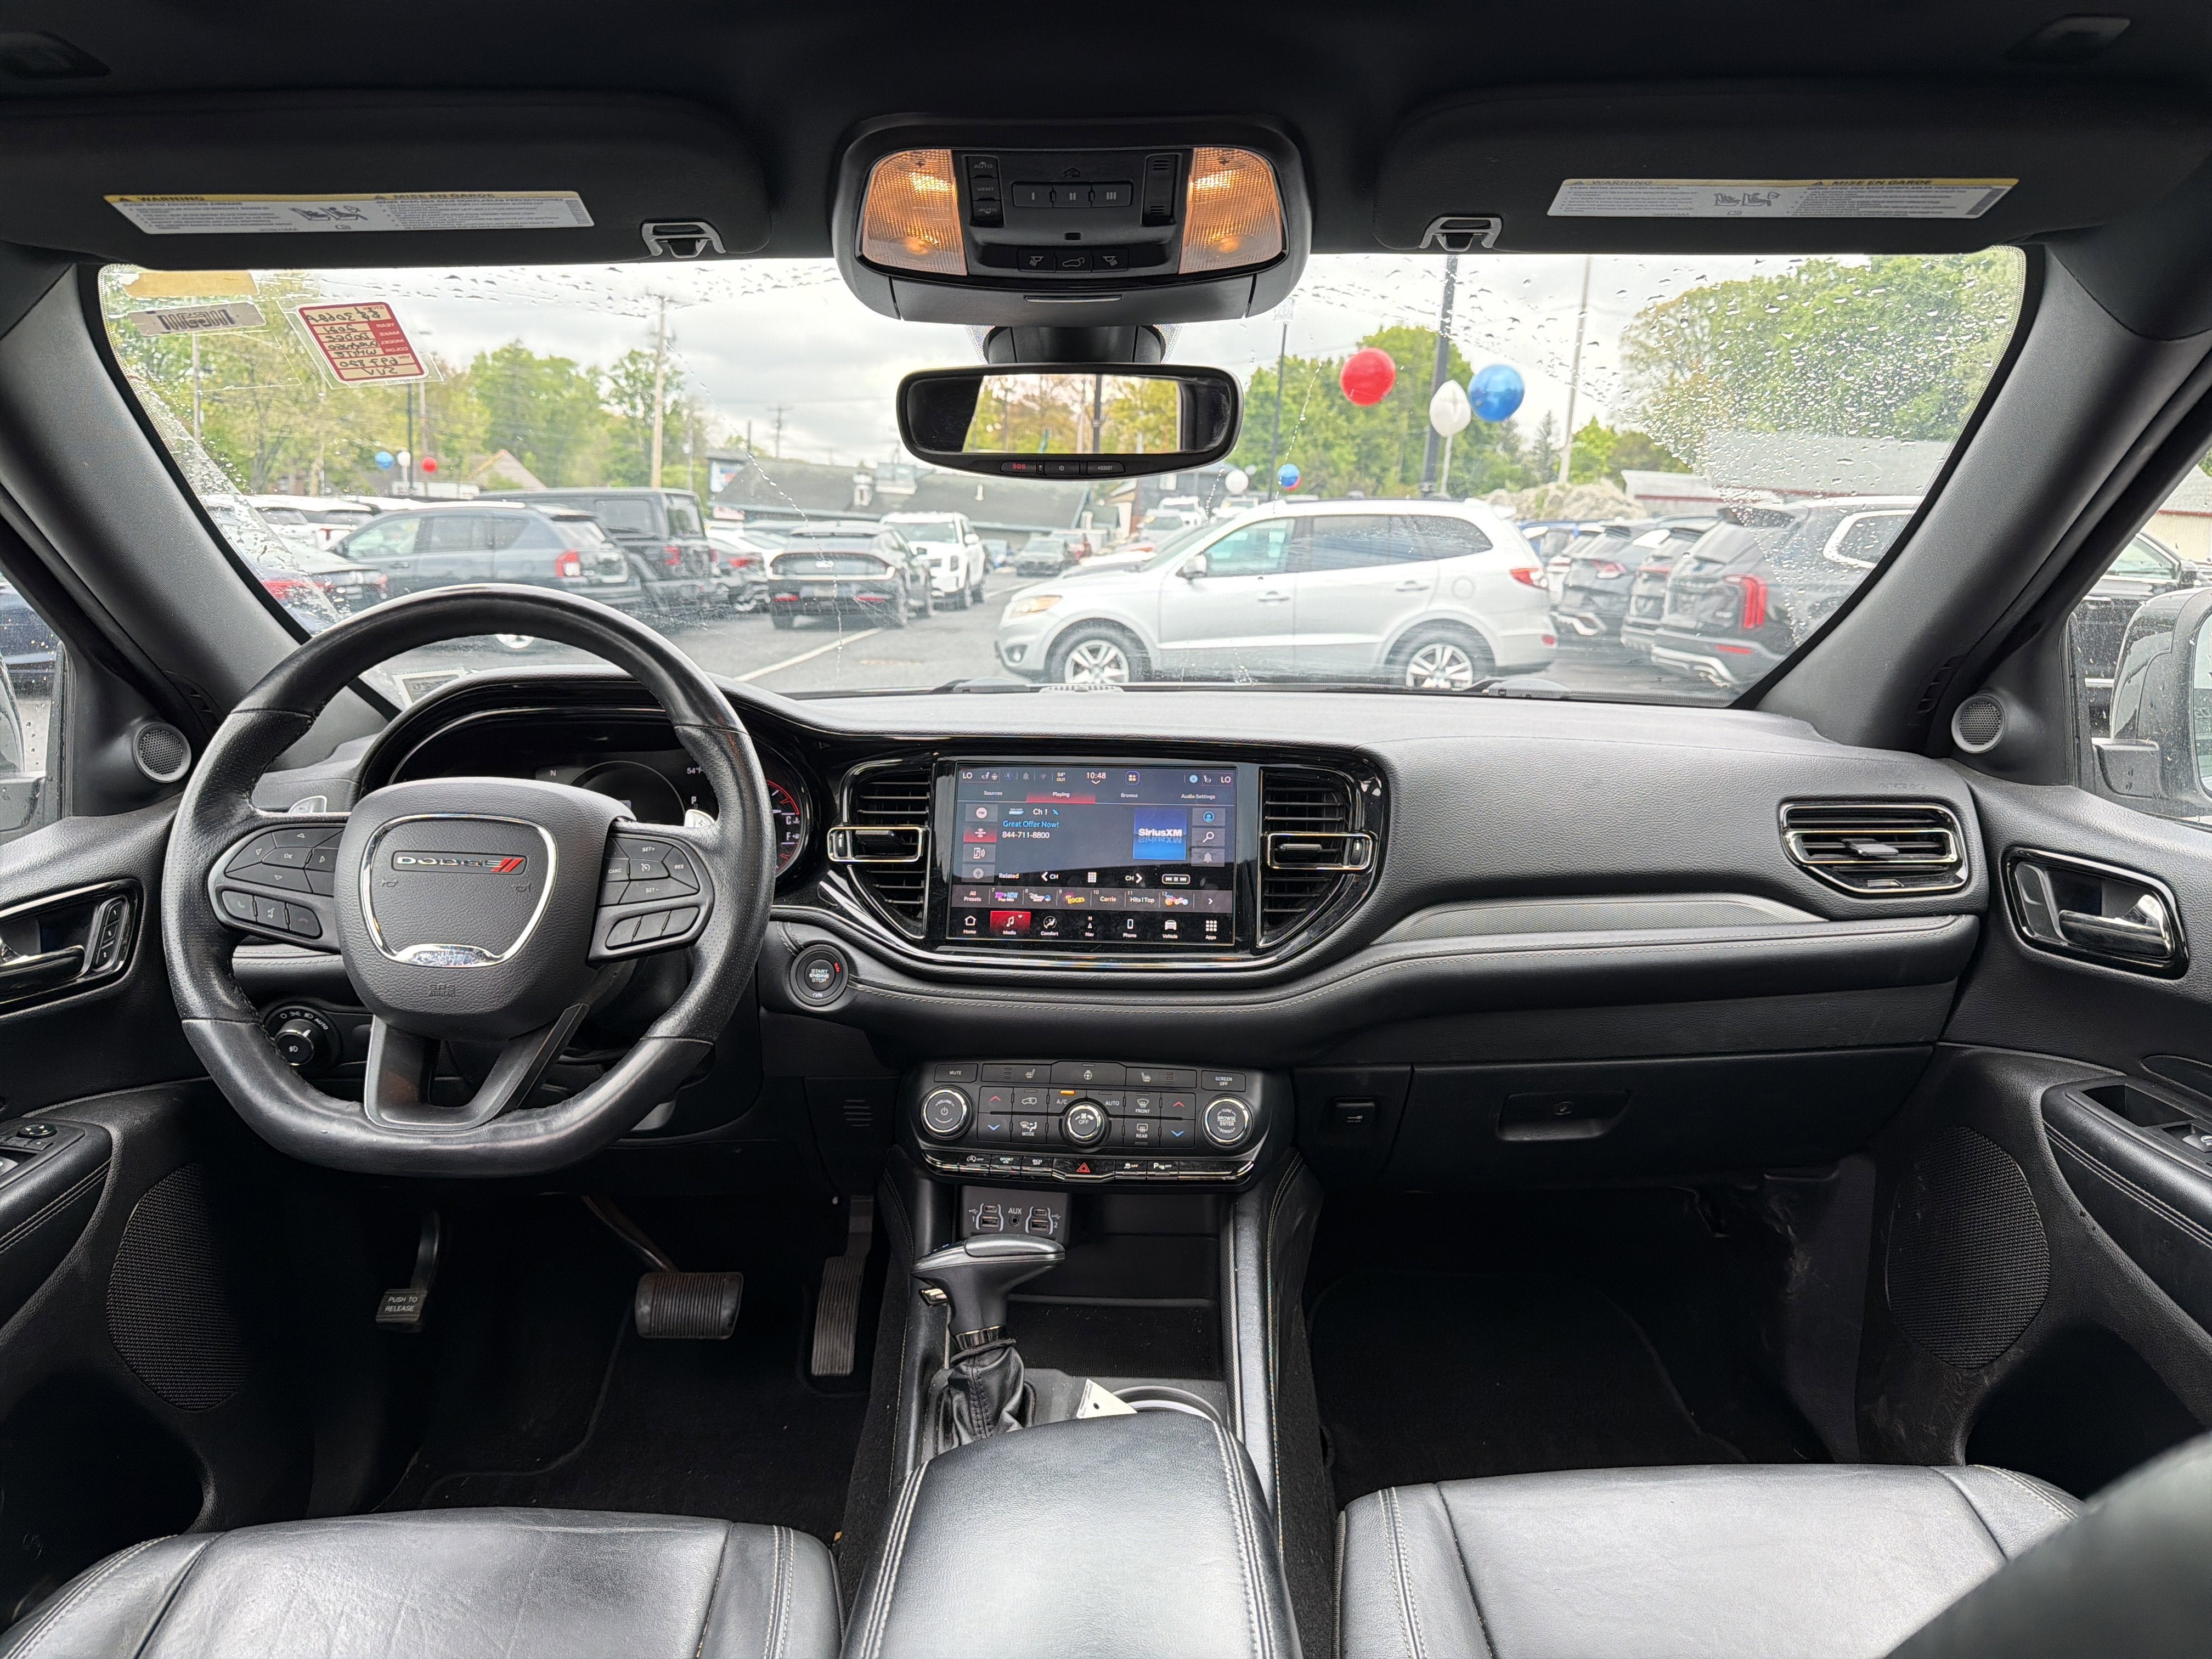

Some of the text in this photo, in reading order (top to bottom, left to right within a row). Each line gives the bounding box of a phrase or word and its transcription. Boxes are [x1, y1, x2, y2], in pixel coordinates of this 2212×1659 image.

[691, 796, 696, 804] P
[786, 816, 792, 825] C
[786, 832, 791, 841] F
[1138, 828, 1182, 837] SiriusXM
[396, 856, 504, 868] DODGE
[314, 1018, 329, 1030] AUTO
